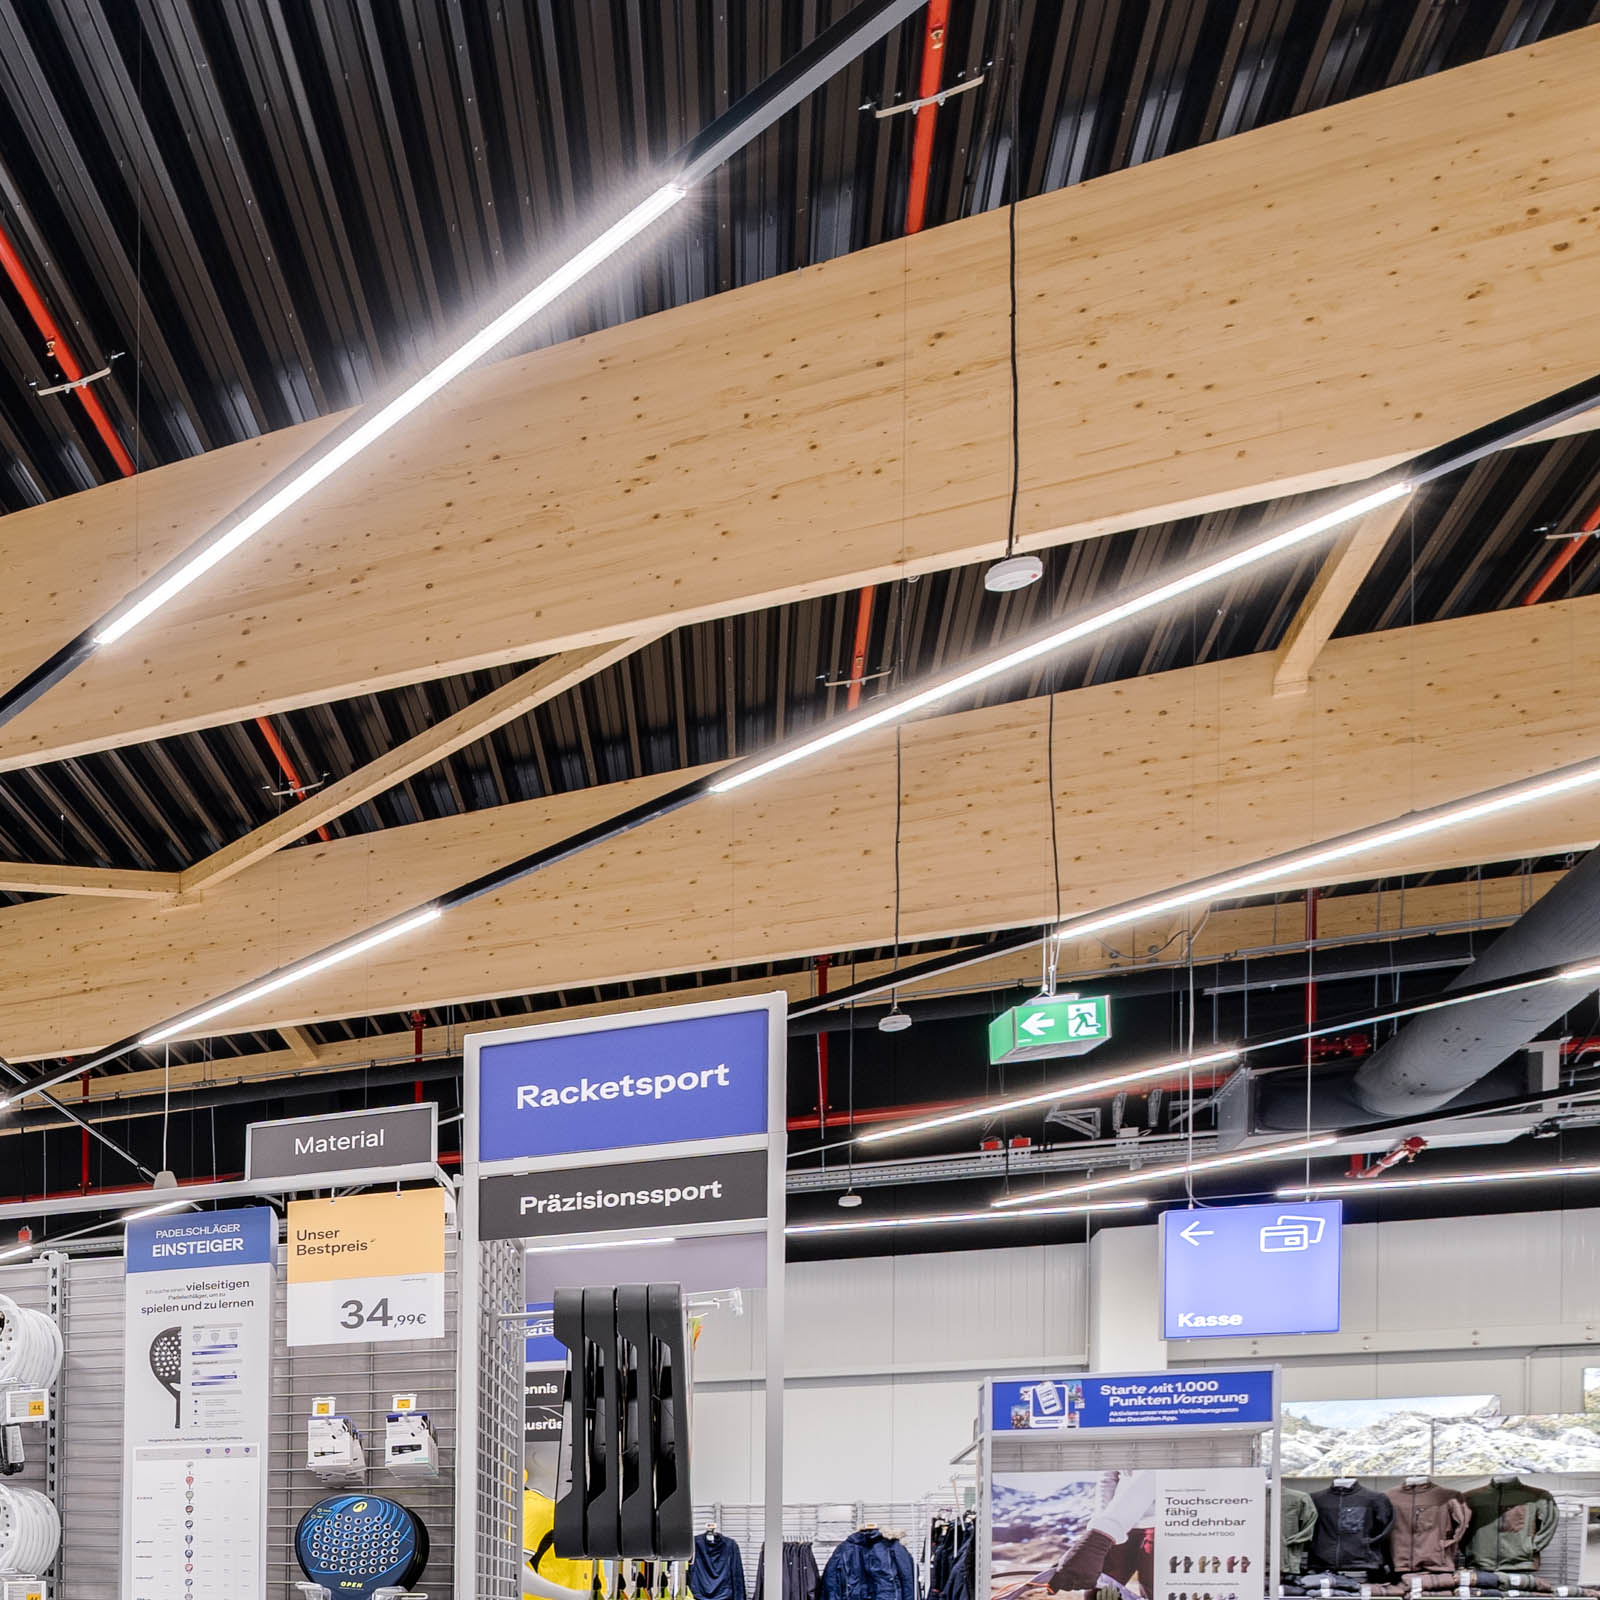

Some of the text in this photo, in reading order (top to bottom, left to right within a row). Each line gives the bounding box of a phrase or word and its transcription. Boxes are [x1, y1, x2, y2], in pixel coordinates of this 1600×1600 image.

[516, 1063, 730, 1110] Racketsport
[294, 1128, 385, 1155] Material
[519, 1180, 723, 1215] Präzisionssport
[155, 1223, 241, 1239] PADELSCHLÄGER
[296, 1229, 340, 1241] Unser
[152, 1237, 244, 1257] EINSTEIGER
[296, 1239, 369, 1256] Bestpreis
[186, 1279, 250, 1292] vielseitigen
[141, 1303, 179, 1315] spielen
[181, 1301, 202, 1311] und
[219, 1299, 254, 1309] lernen
[1178, 1312, 1243, 1329] Kasse
[1100, 1384, 1147, 1395] Starte
[1175, 1381, 1218, 1393] 1.000
[1109, 1393, 1249, 1407] Punkten Vorsprung
[1165, 1497, 1254, 1505] Touchscreen-
[1165, 1507, 1198, 1517] fähig
[1164, 1517, 1246, 1527] und dehnbar
[340, 1581, 364, 1589] OPEN
